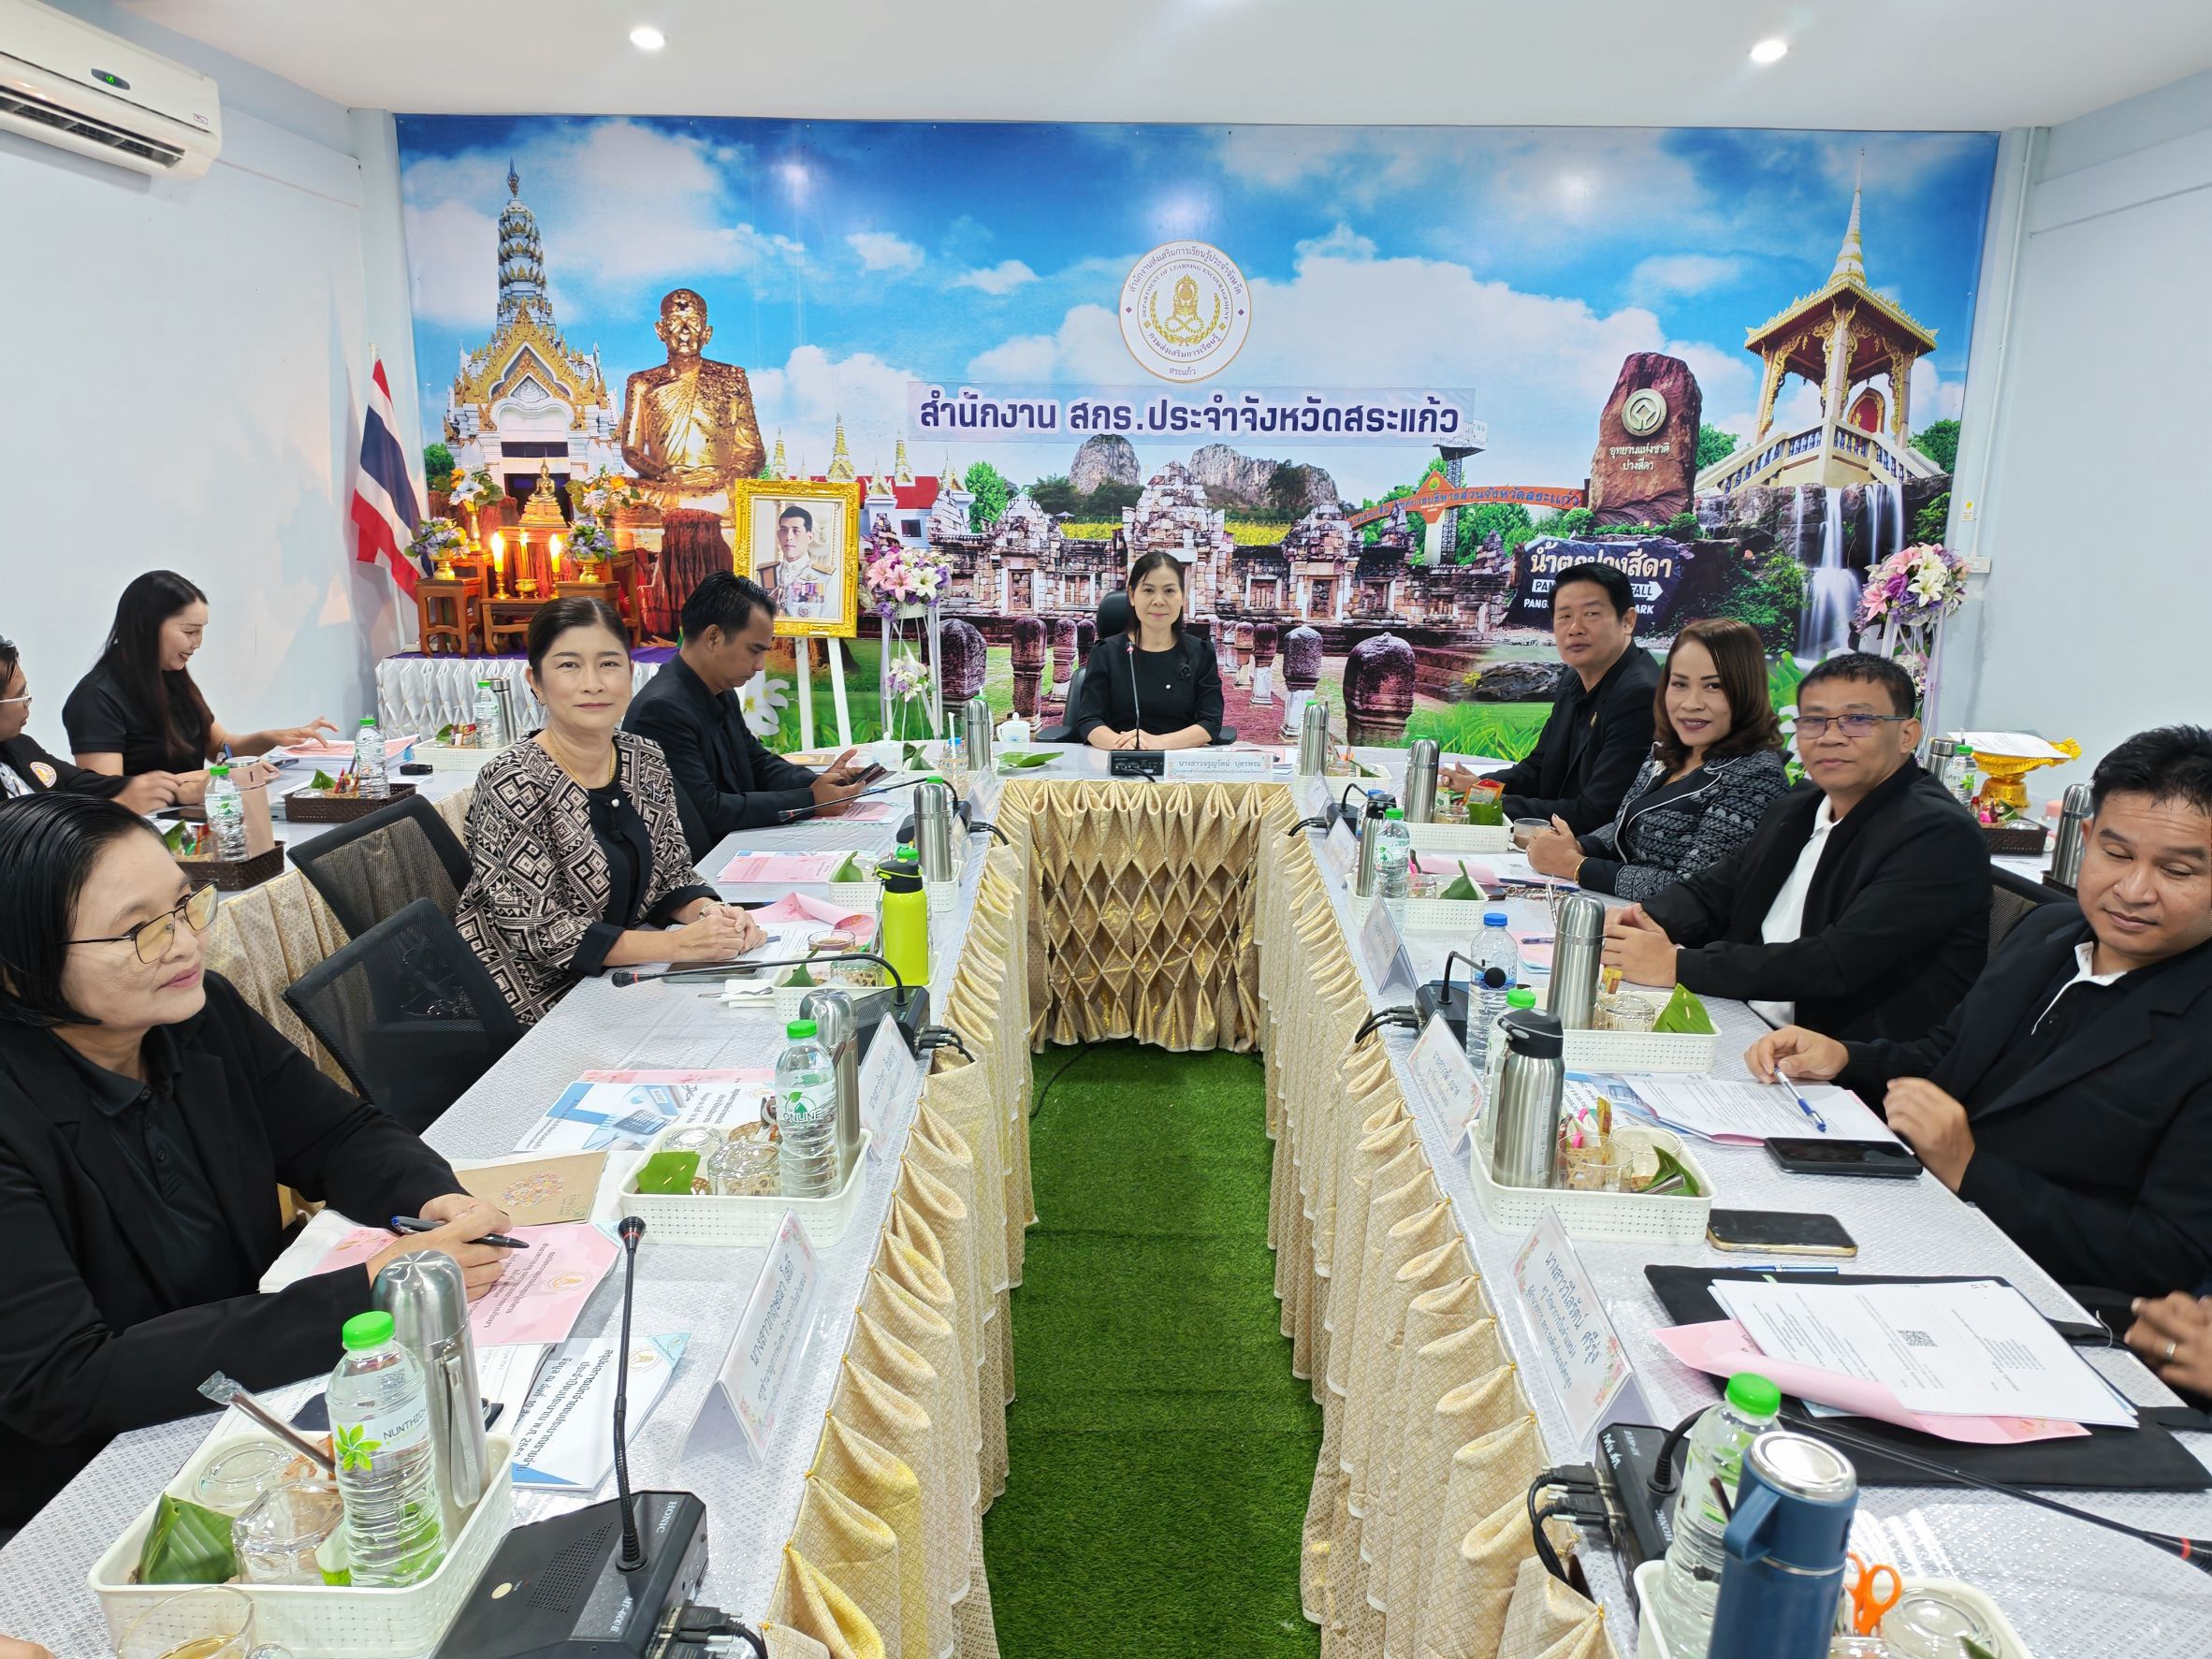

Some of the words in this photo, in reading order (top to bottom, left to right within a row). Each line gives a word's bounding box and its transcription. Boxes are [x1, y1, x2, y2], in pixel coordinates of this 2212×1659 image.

[1169, 263, 1202, 273] LEARNING
[1169, 366, 1197, 376] สระแก้ว
[920, 389, 1056, 429] สำนักงาน
[1609, 443, 1670, 459] อุทยานแห่งชาติ
[1623, 458, 1654, 471] ปางสีดา
[1545, 1251, 1589, 1331] นางสาววิไลรัตน์
[1581, 1331, 1601, 1364] ศรีรุ่ง
[657, 1500, 678, 1535] HONIC
